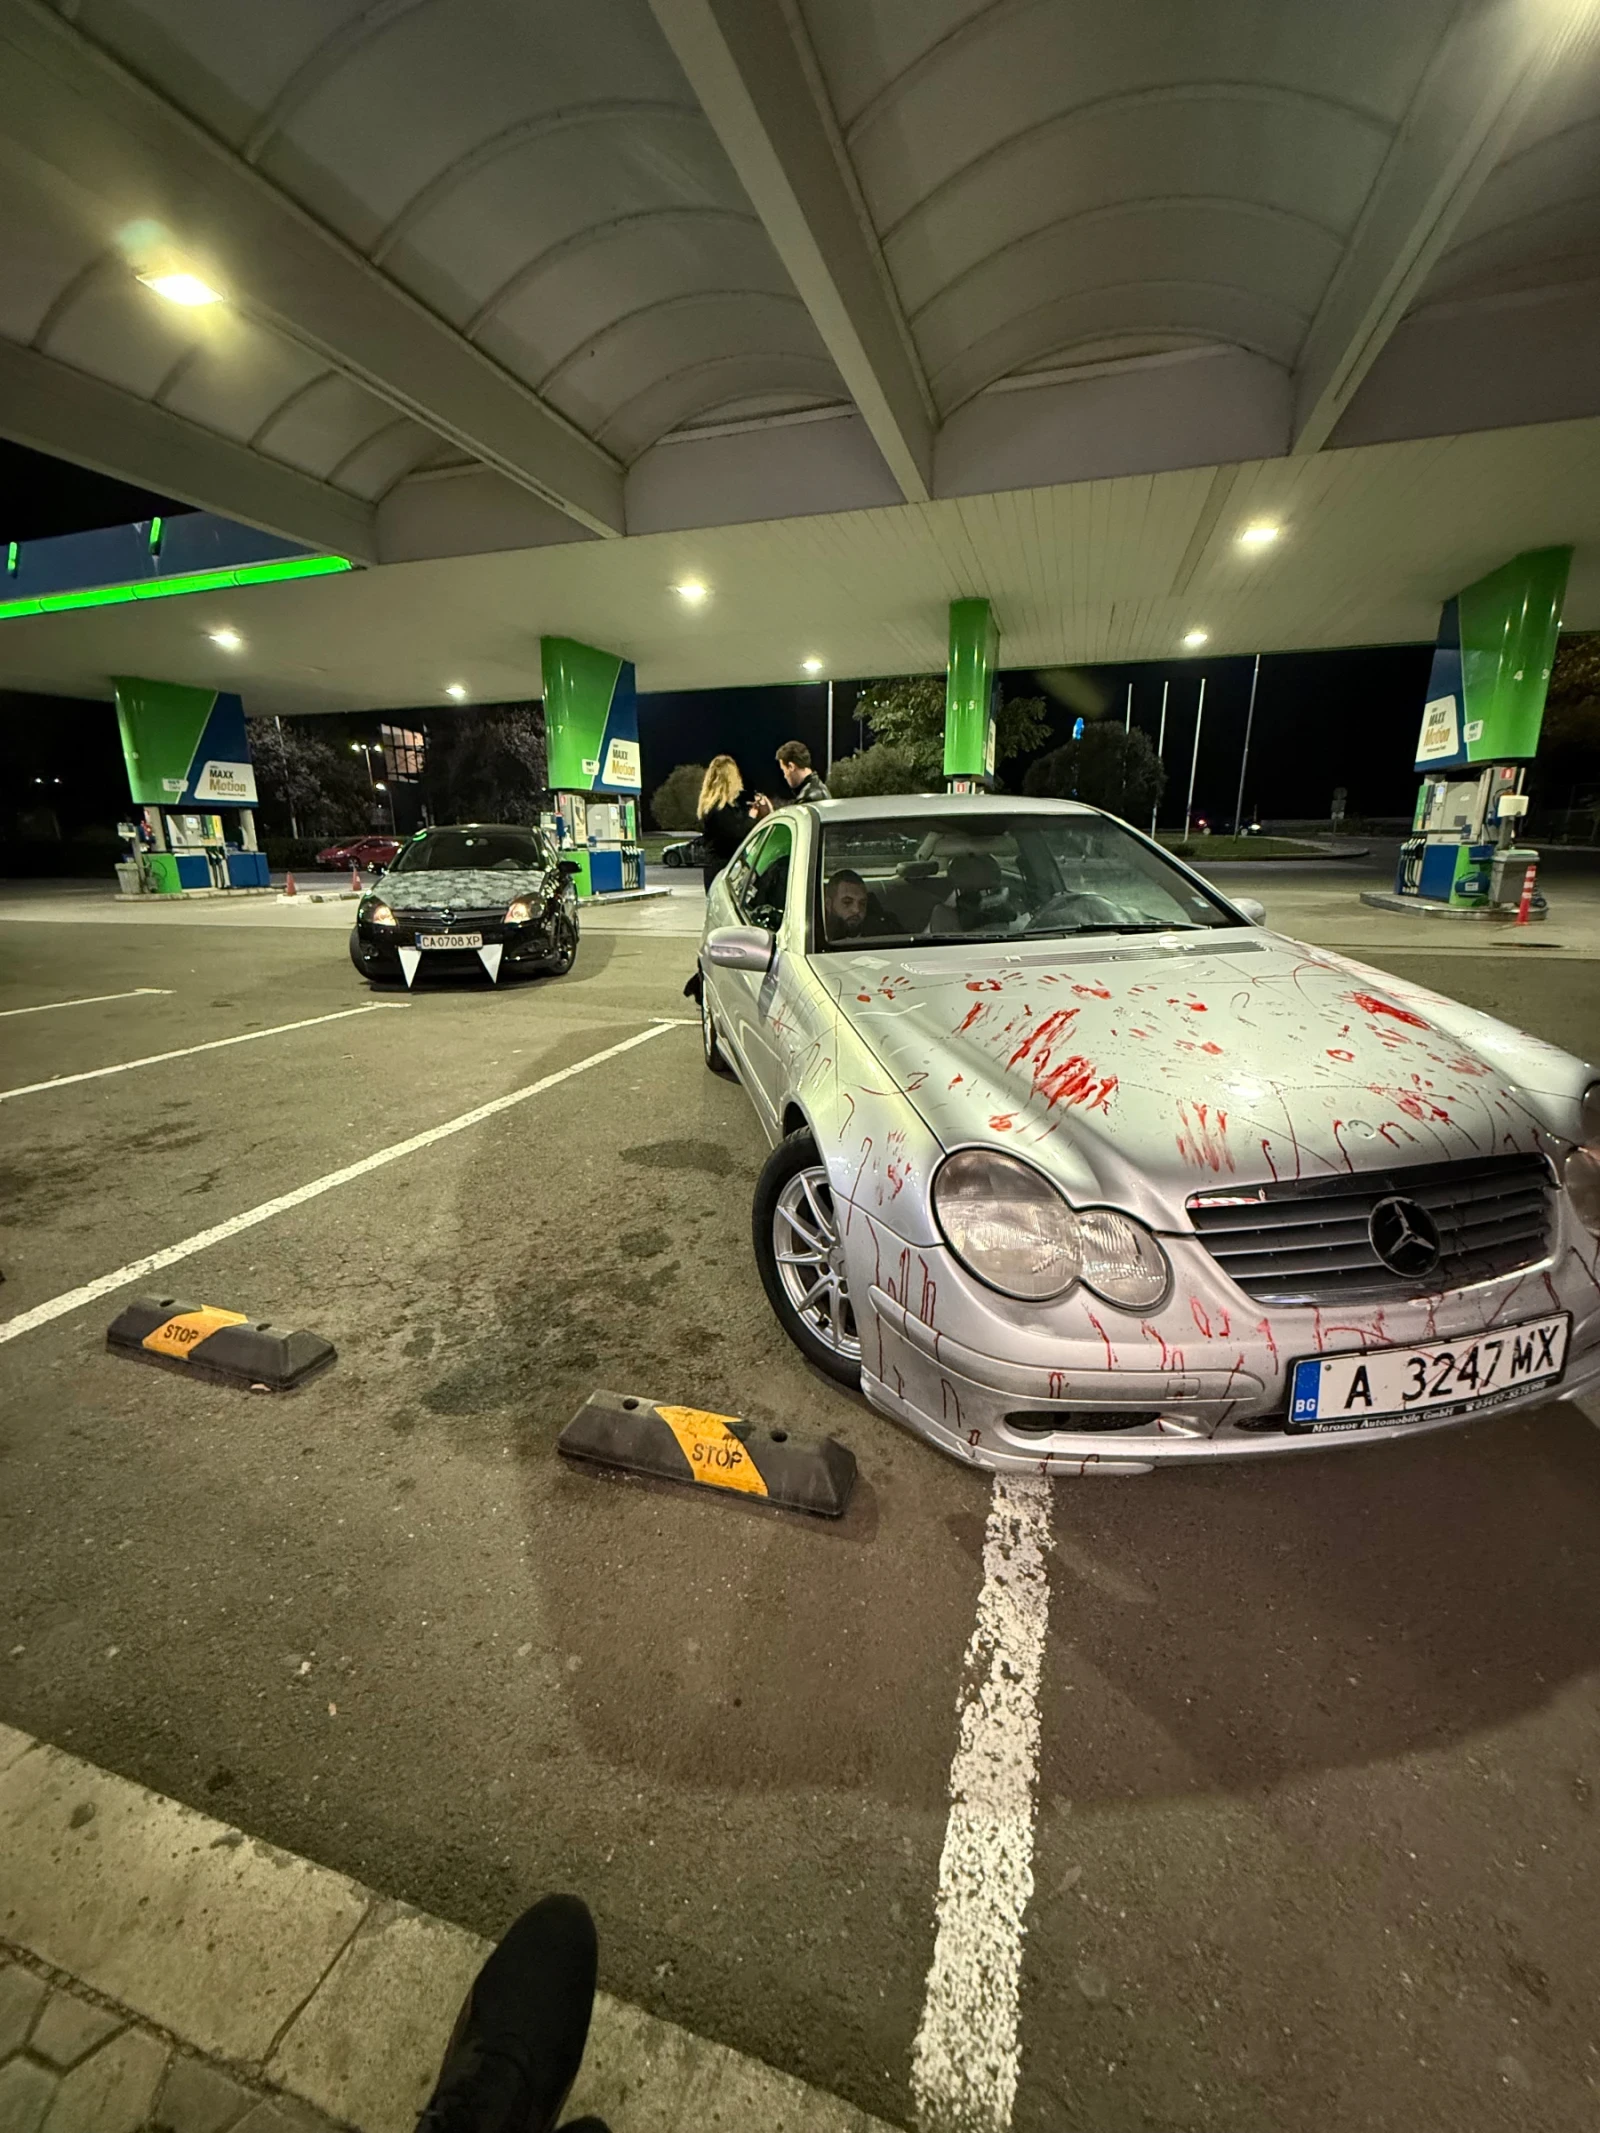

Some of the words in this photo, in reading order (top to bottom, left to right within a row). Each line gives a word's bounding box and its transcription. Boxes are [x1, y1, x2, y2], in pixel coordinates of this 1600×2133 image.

[952, 701, 958, 711] 6
[968, 700, 975, 710] 5
[1424, 726, 1451, 747] Motion
[612, 748, 628, 760] MAXX
[209, 769, 234, 779] MAXX
[612, 760, 635, 776] Motion
[209, 779, 246, 793] Motion
[438, 936, 464, 947] 0708
[466, 936, 480, 946] XP
[164, 1324, 199, 1343] STOP
[1344, 1365, 1373, 1409] A
[1402, 1340, 1504, 1401] 3247
[1510, 1325, 1560, 1378] MX
[1295, 1398, 1316, 1412] BG
[1360, 1415, 1420, 1429] Automobile
[1422, 1407, 1454, 1420] GmbH
[692, 1443, 743, 1469] STOP
